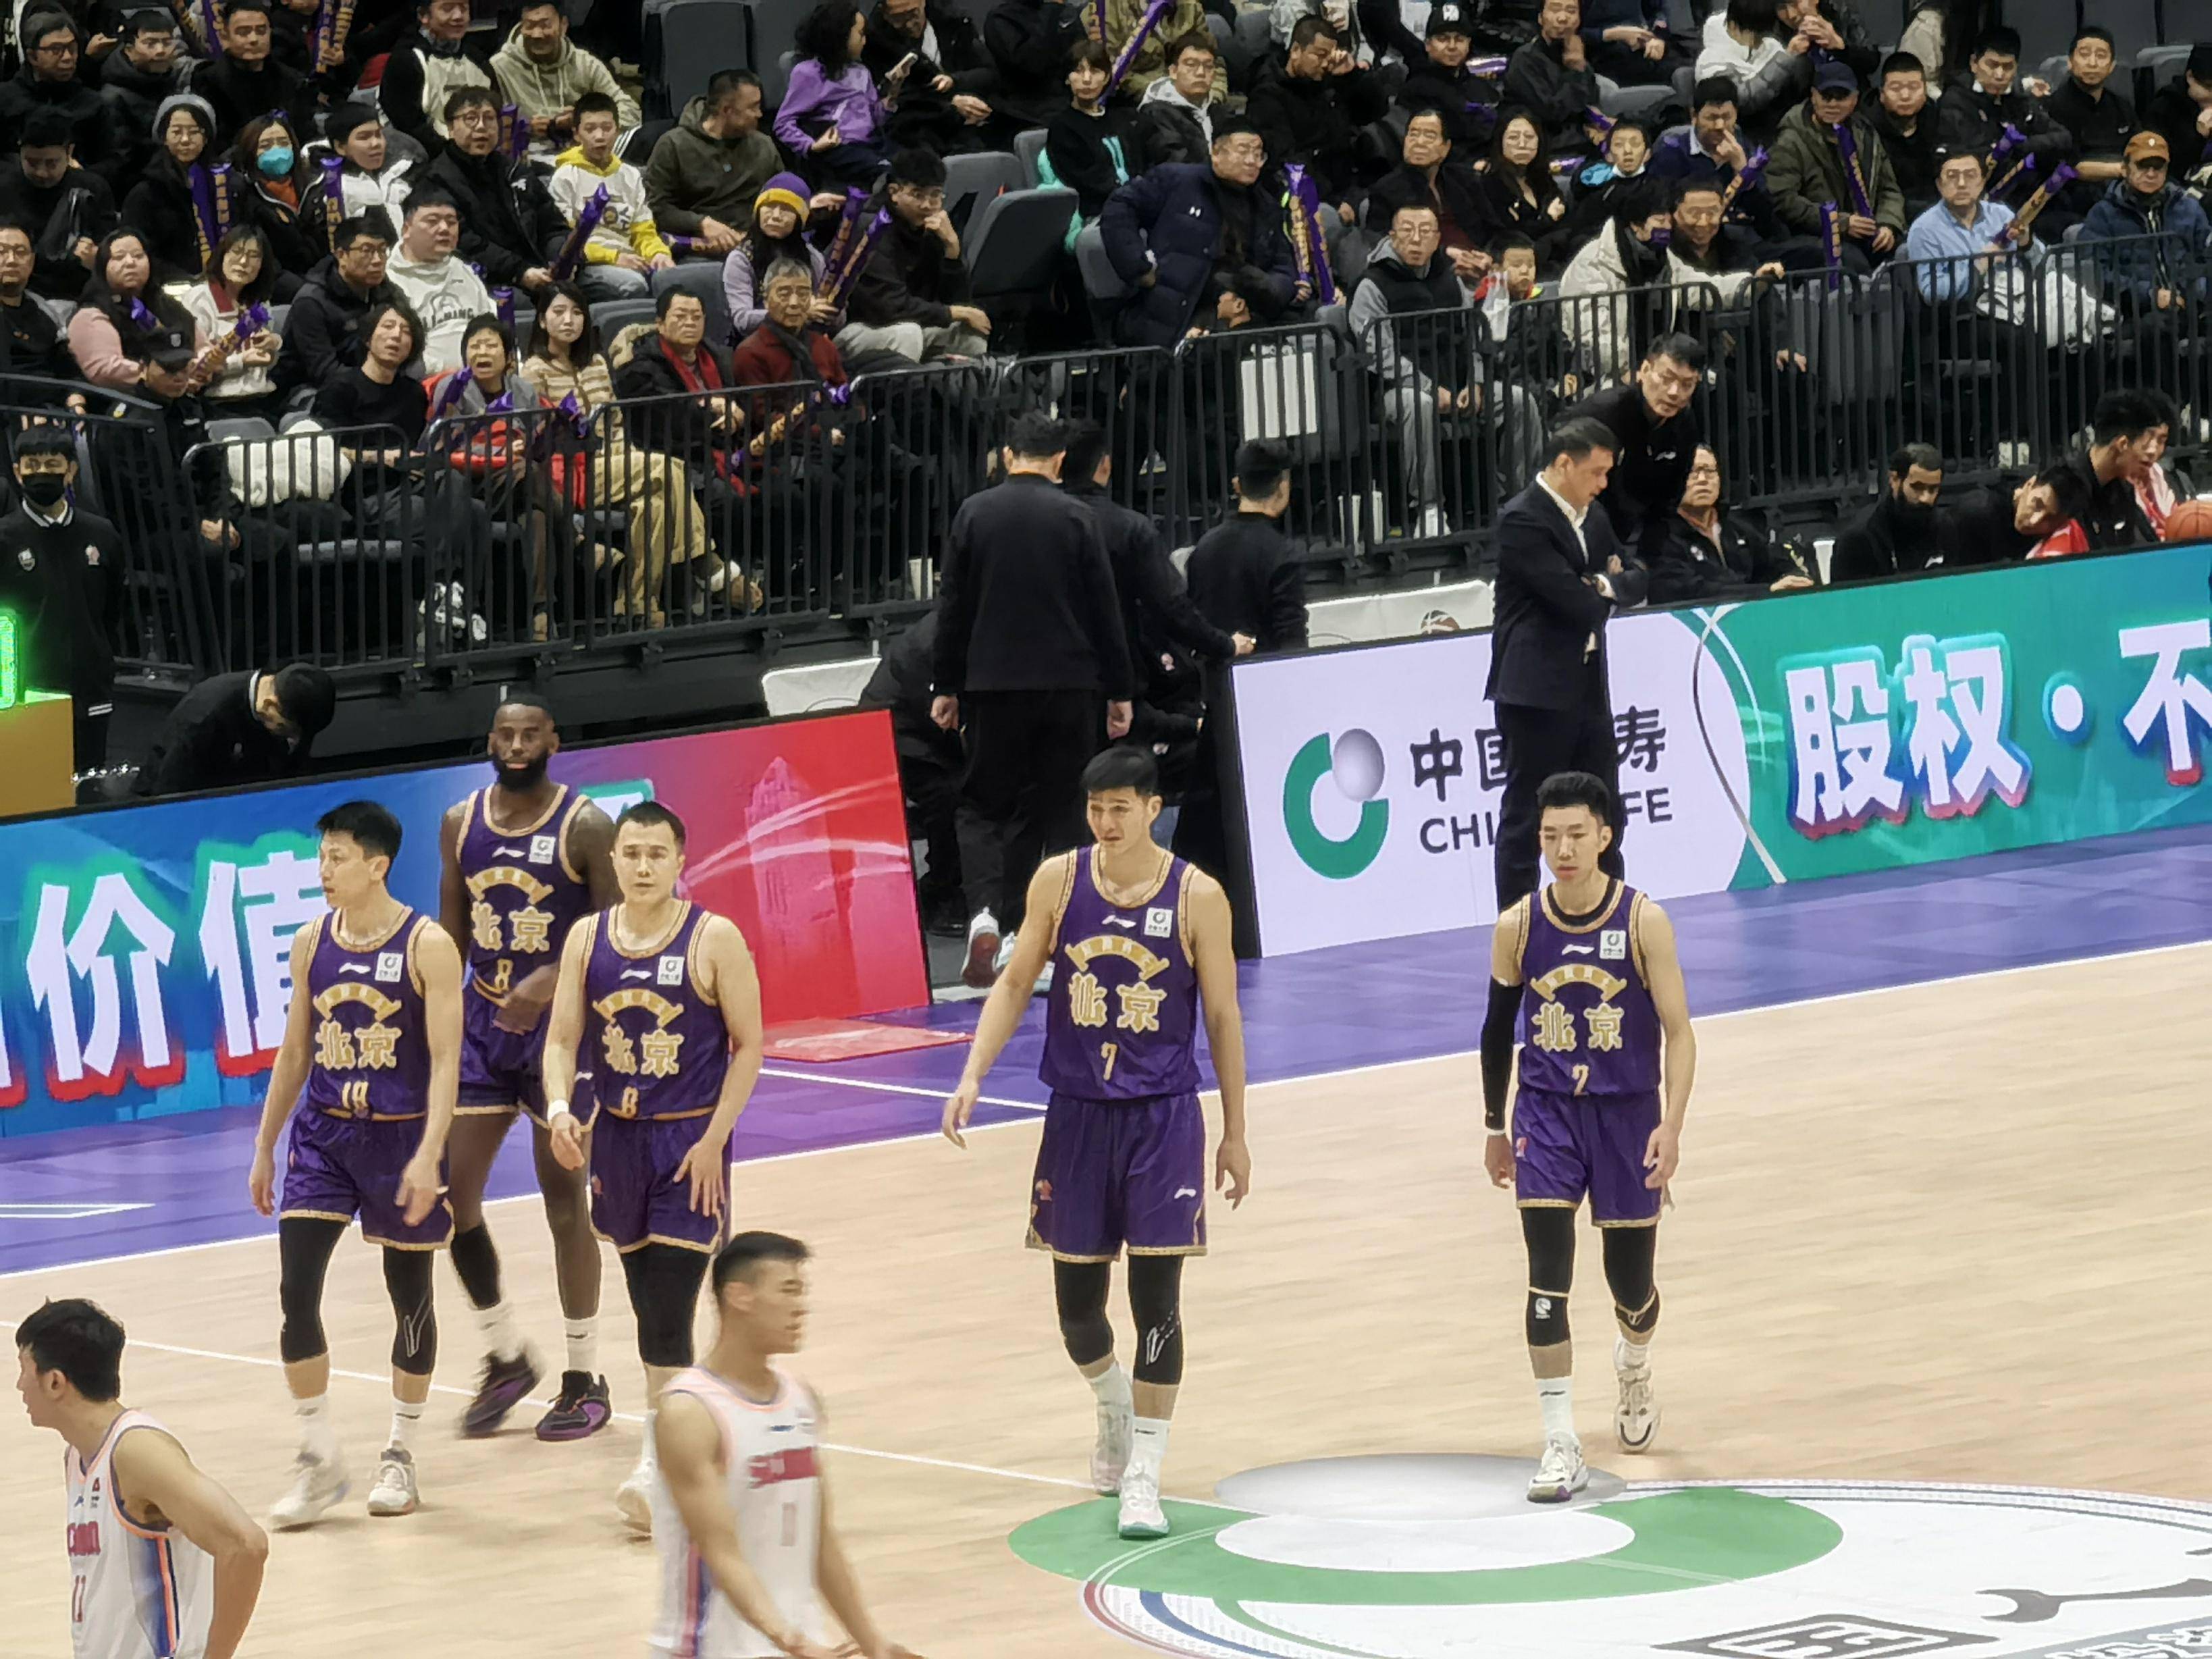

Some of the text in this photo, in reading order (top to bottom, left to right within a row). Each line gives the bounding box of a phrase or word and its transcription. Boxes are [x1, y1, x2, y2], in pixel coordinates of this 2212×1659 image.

[1410, 706, 1666, 802] 中国寿
[470, 901, 556, 954] 北京
[0, 851, 321, 1089] 价值
[1068, 972, 1168, 1034] 北京
[1531, 1001, 1625, 1052] 北京
[315, 1020, 402, 1071] 北京
[602, 1024, 685, 1079] 北京
[1101, 1041, 1118, 1080] 7
